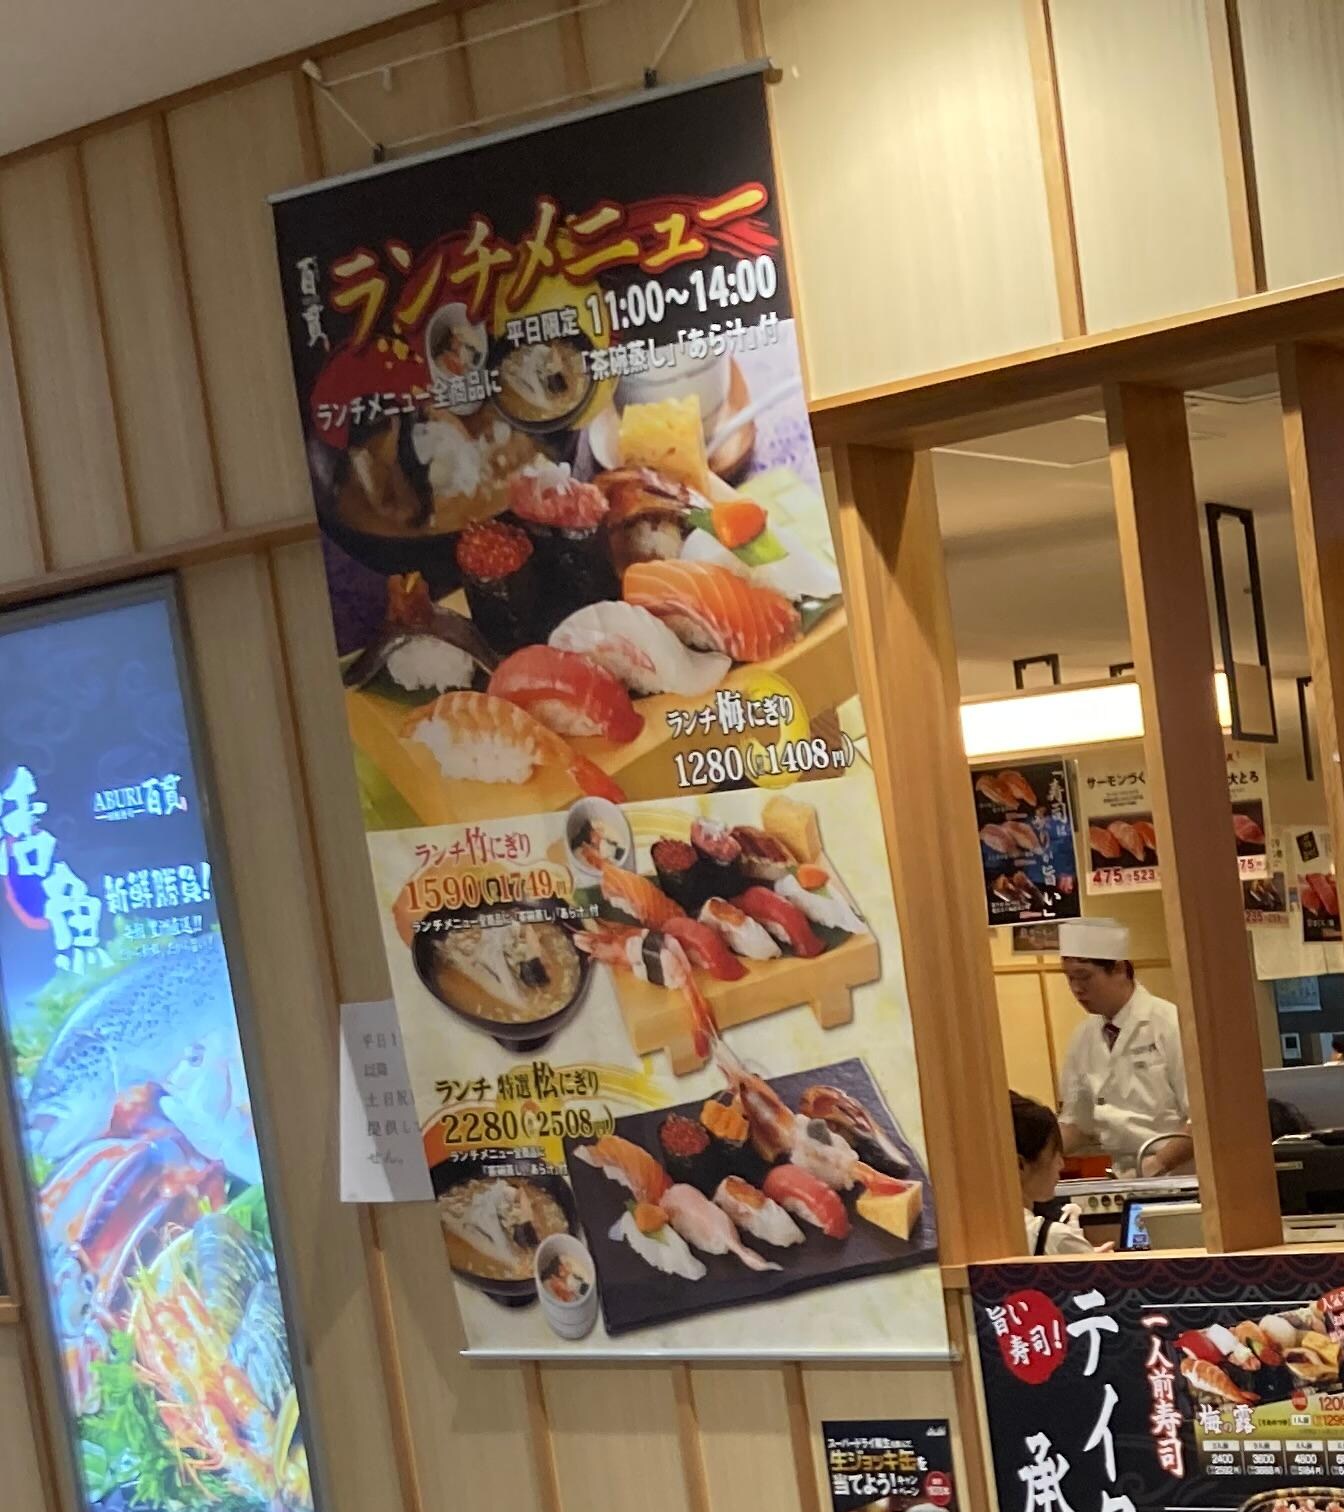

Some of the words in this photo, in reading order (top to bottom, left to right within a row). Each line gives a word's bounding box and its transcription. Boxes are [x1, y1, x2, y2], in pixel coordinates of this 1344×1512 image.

[333, 187, 766, 348] ランチメニュー
[506, 307, 580, 346] 平日限定
[317, 370, 502, 432] ランチメニュー全商品に
[667, 690, 794, 738] ランチ梅にぎり
[415, 825, 531, 867] ランチ竹にぎり
[985, 1301, 1028, 1336] 旨い
[1009, 1320, 1062, 1365] 寿司!
[1141, 1314, 1186, 1479] 一人前寿司
[1199, 1404, 1256, 1435] 梅の露
